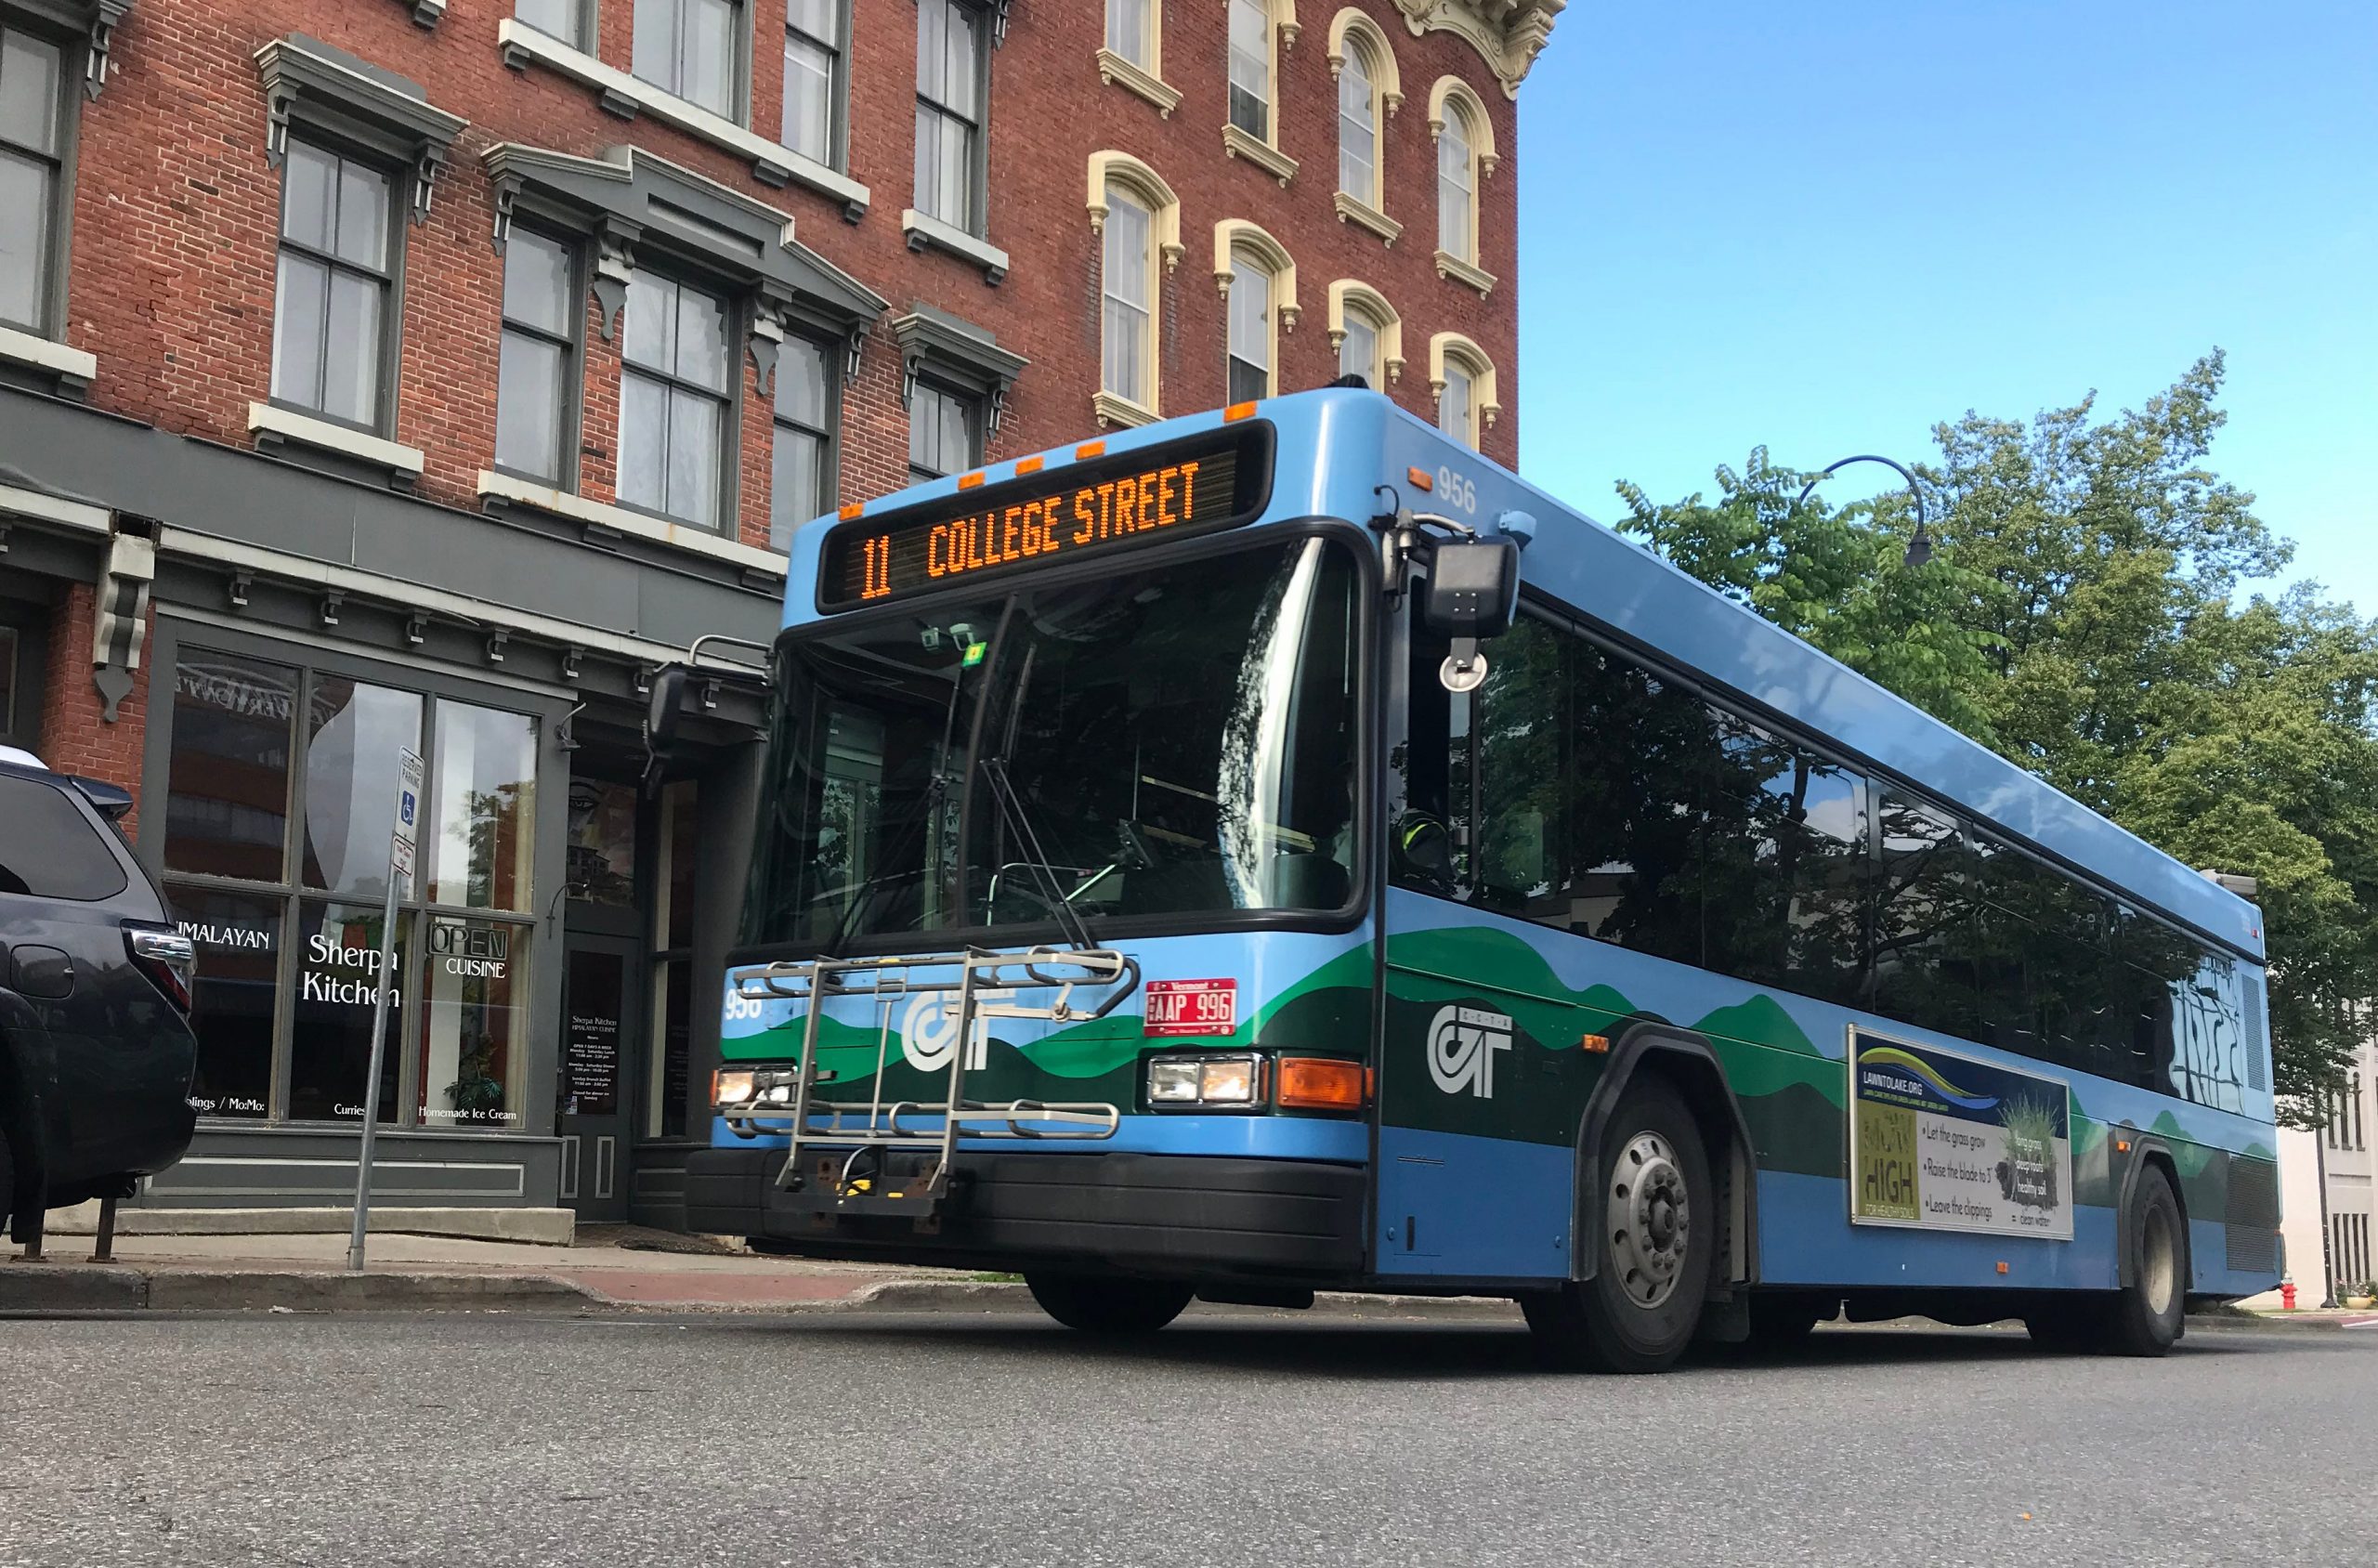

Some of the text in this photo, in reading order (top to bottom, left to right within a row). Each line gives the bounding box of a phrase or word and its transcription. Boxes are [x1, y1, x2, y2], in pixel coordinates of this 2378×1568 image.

[1439, 465, 1475, 515] 956
[862, 463, 1199, 599] 11 COLLEGE STREET
[401, 753, 422, 777] RESERVED
[401, 767, 420, 790] PARKING
[176, 921, 269, 949] IMALAYAN
[434, 926, 504, 957] OPEN
[446, 958, 505, 979] CUISINE
[1170, 982, 1209, 991] Vermont
[572, 1015, 617, 1026] Sherpa Kitchen
[1155, 993, 1230, 1022] AAP 996
[1863, 1071, 1923, 1096] LAWNTOLAKE.ORG
[419, 1105, 516, 1120] Homemade Ice Cream
[1927, 1121, 1986, 1151] Let the grass grow
[1865, 1156, 1914, 1205] HIGH
[1927, 1157, 1946, 1178] Raise
[1947, 1159, 1958, 1180] the
[1960, 1161, 1978, 1182] blade
[1979, 1167, 1986, 1183] to
[1929, 1194, 1993, 1222] Leave the clippings
